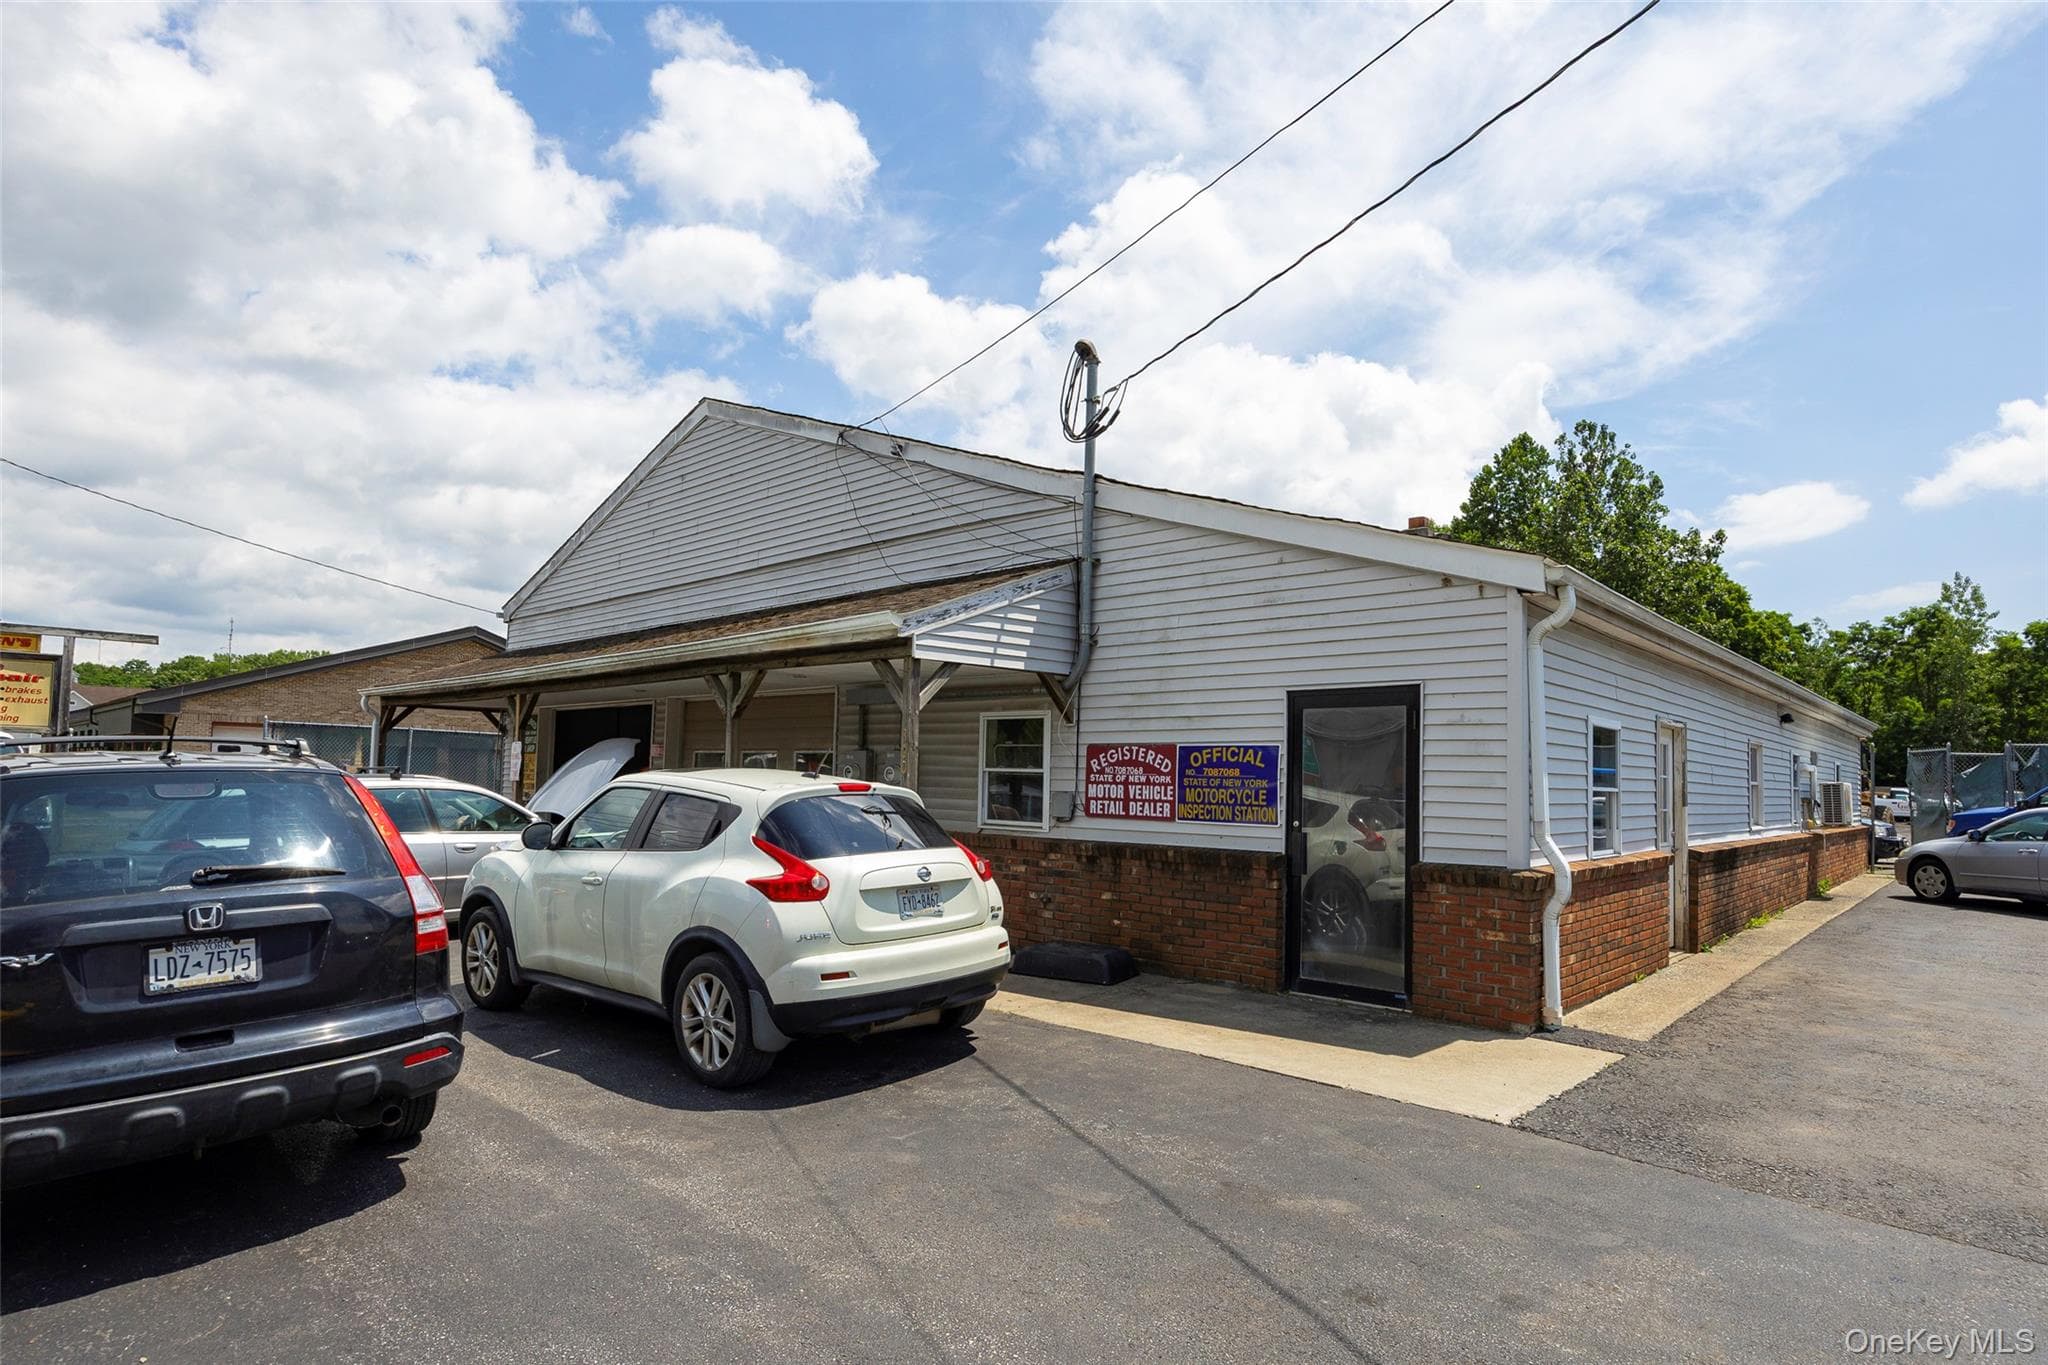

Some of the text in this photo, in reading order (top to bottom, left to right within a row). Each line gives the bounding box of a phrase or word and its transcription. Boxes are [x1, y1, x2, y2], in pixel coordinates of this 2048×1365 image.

[0, 636, 32, 648] N'S
[5, 686, 42, 695] brakes
[5, 696, 48, 705] exhaust
[1090, 746, 1172, 773] REGISTERED
[1190, 747, 1264, 768] OFFICIAL
[1115, 766, 1143, 775] 7087068
[1203, 768, 1240, 776] 7087068
[1090, 774, 1172, 784] STATE OF NEW YORK
[1184, 778, 1268, 788] STATE OF NEW YORK
[1088, 784, 1174, 800] MOTOR VEHICLE
[1186, 788, 1266, 805] MOTORCYCLE
[1090, 800, 1170, 817] RETAIL DEALER
[1179, 804, 1276, 822] INSPECTION STATION
[174, 939, 232, 954] NEW YORK
[154, 948, 251, 982] LDZ 7575
